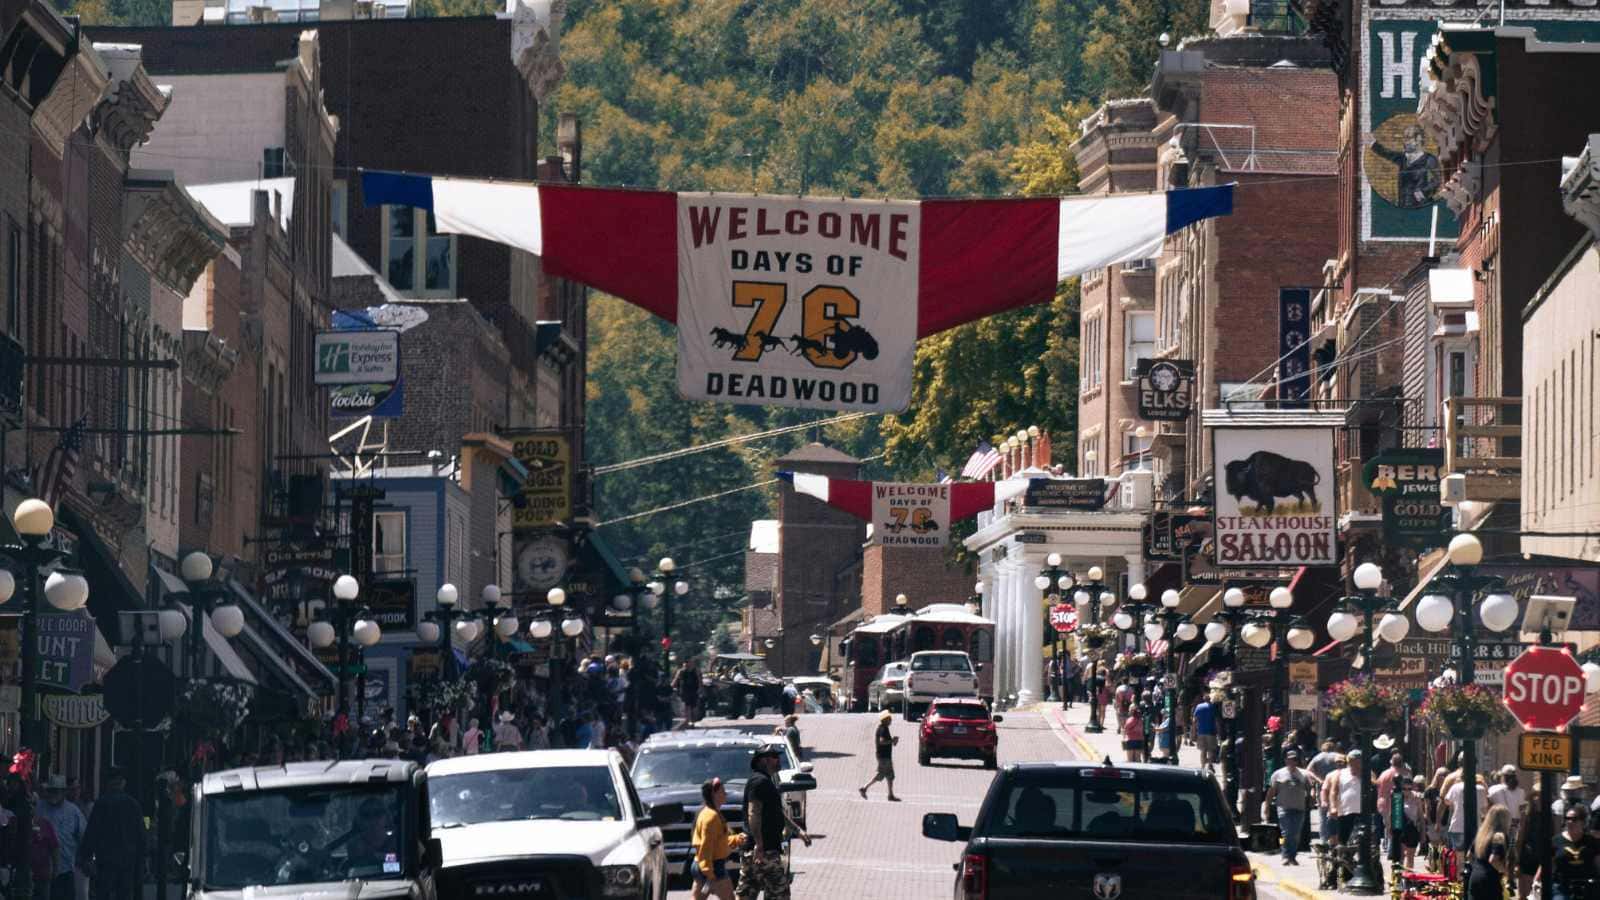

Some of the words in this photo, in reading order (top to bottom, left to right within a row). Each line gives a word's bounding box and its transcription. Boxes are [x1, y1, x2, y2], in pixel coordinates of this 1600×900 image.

[688, 206, 909, 262] WELCOME
[731, 249, 813, 274] DAYS
[826, 254, 863, 277] OF
[731, 280, 860, 370] 76
[706, 372, 880, 404] DEADWOOD
[330, 389, 376, 408] Tootsie
[1142, 391, 1186, 408] ELKS
[513, 440, 559, 457] GOLD
[1378, 464, 1440, 481] BER
[876, 486, 947, 500] WELCOME
[1402, 484, 1441, 495] JEWE
[889, 498, 916, 506] DAYS
[1393, 504, 1441, 518] GOLD
[890, 507, 932, 535] 76
[1217, 516, 1333, 530] STEAKHOUSE
[882, 536, 939, 545] DEADWOOD
[1220, 532, 1330, 561] SALOON
[1053, 611, 1077, 624] STOP
[37, 635, 81, 658] UNT
[1428, 643, 1451, 655] Hill
[1509, 670, 1582, 706] STOP
[1532, 737, 1561, 751] PED
[1529, 752, 1563, 766] XING
